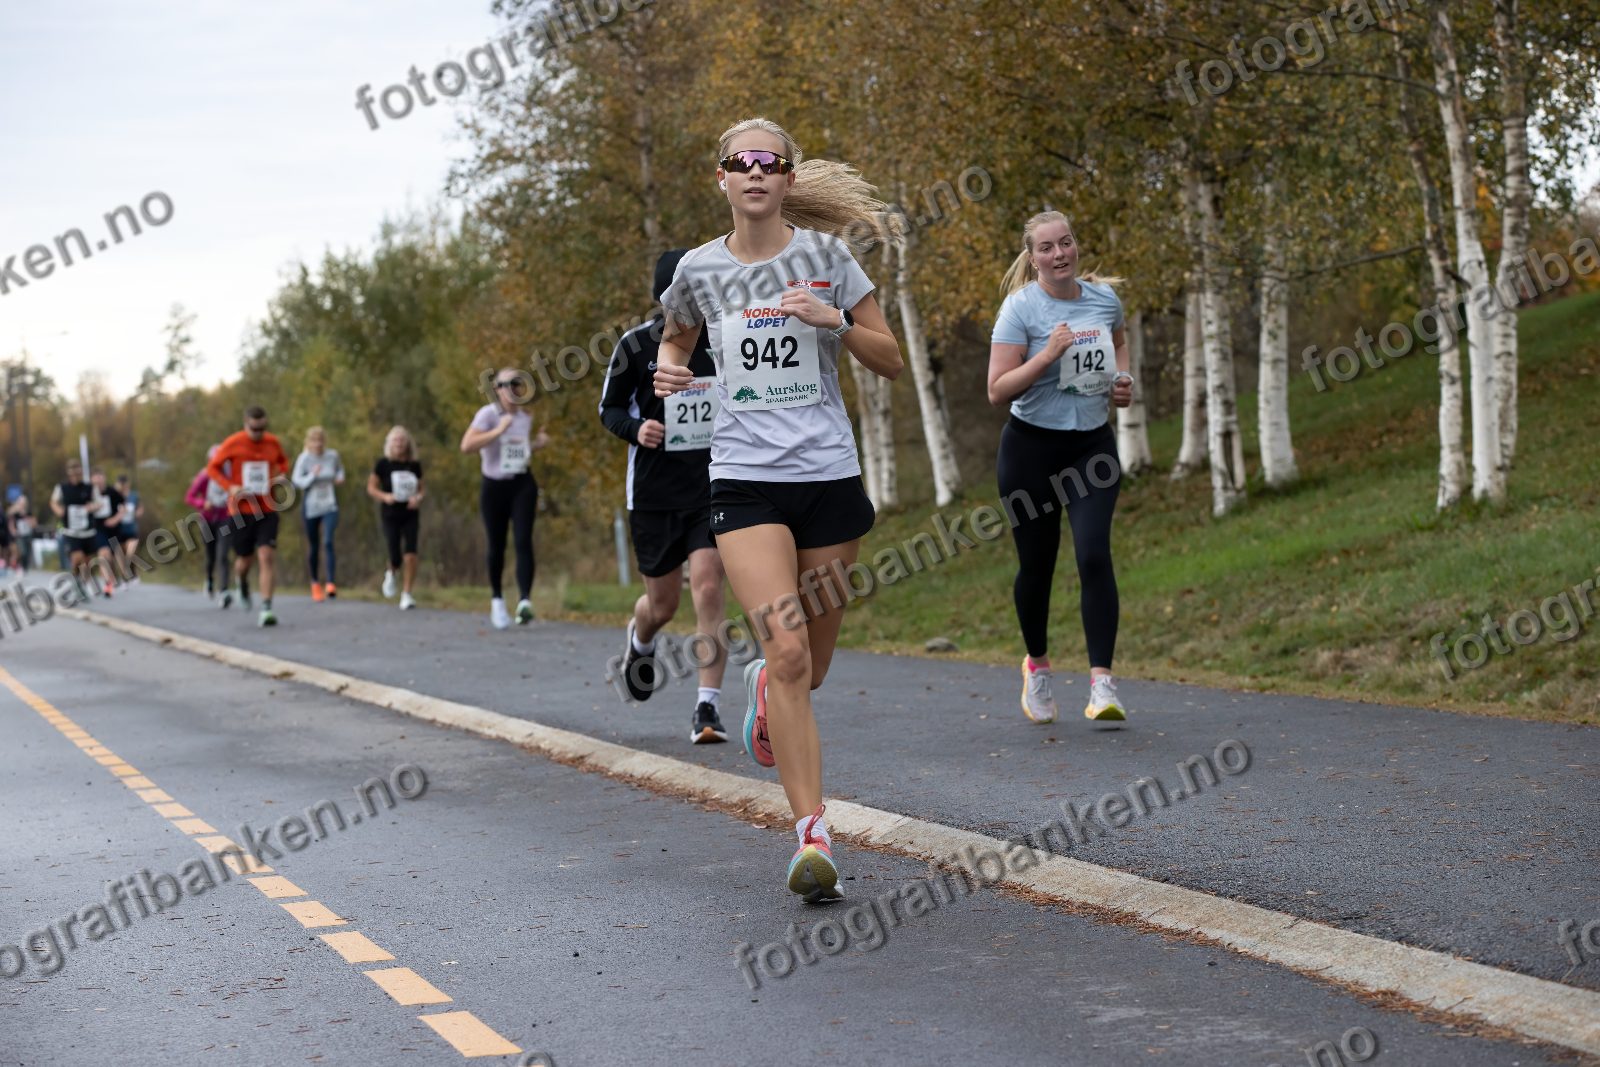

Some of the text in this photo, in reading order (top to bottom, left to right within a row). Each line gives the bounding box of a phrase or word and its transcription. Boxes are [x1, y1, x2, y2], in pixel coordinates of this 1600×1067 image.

[742, 307, 789, 318] NORG
[747, 317, 789, 328] LØPET
[740, 335, 800, 371] 942
[1072, 349, 1105, 374] 142
[765, 382, 817, 396] Aurskog
[765, 395, 808, 404] SPAREBANK
[677, 401, 712, 424] 212
